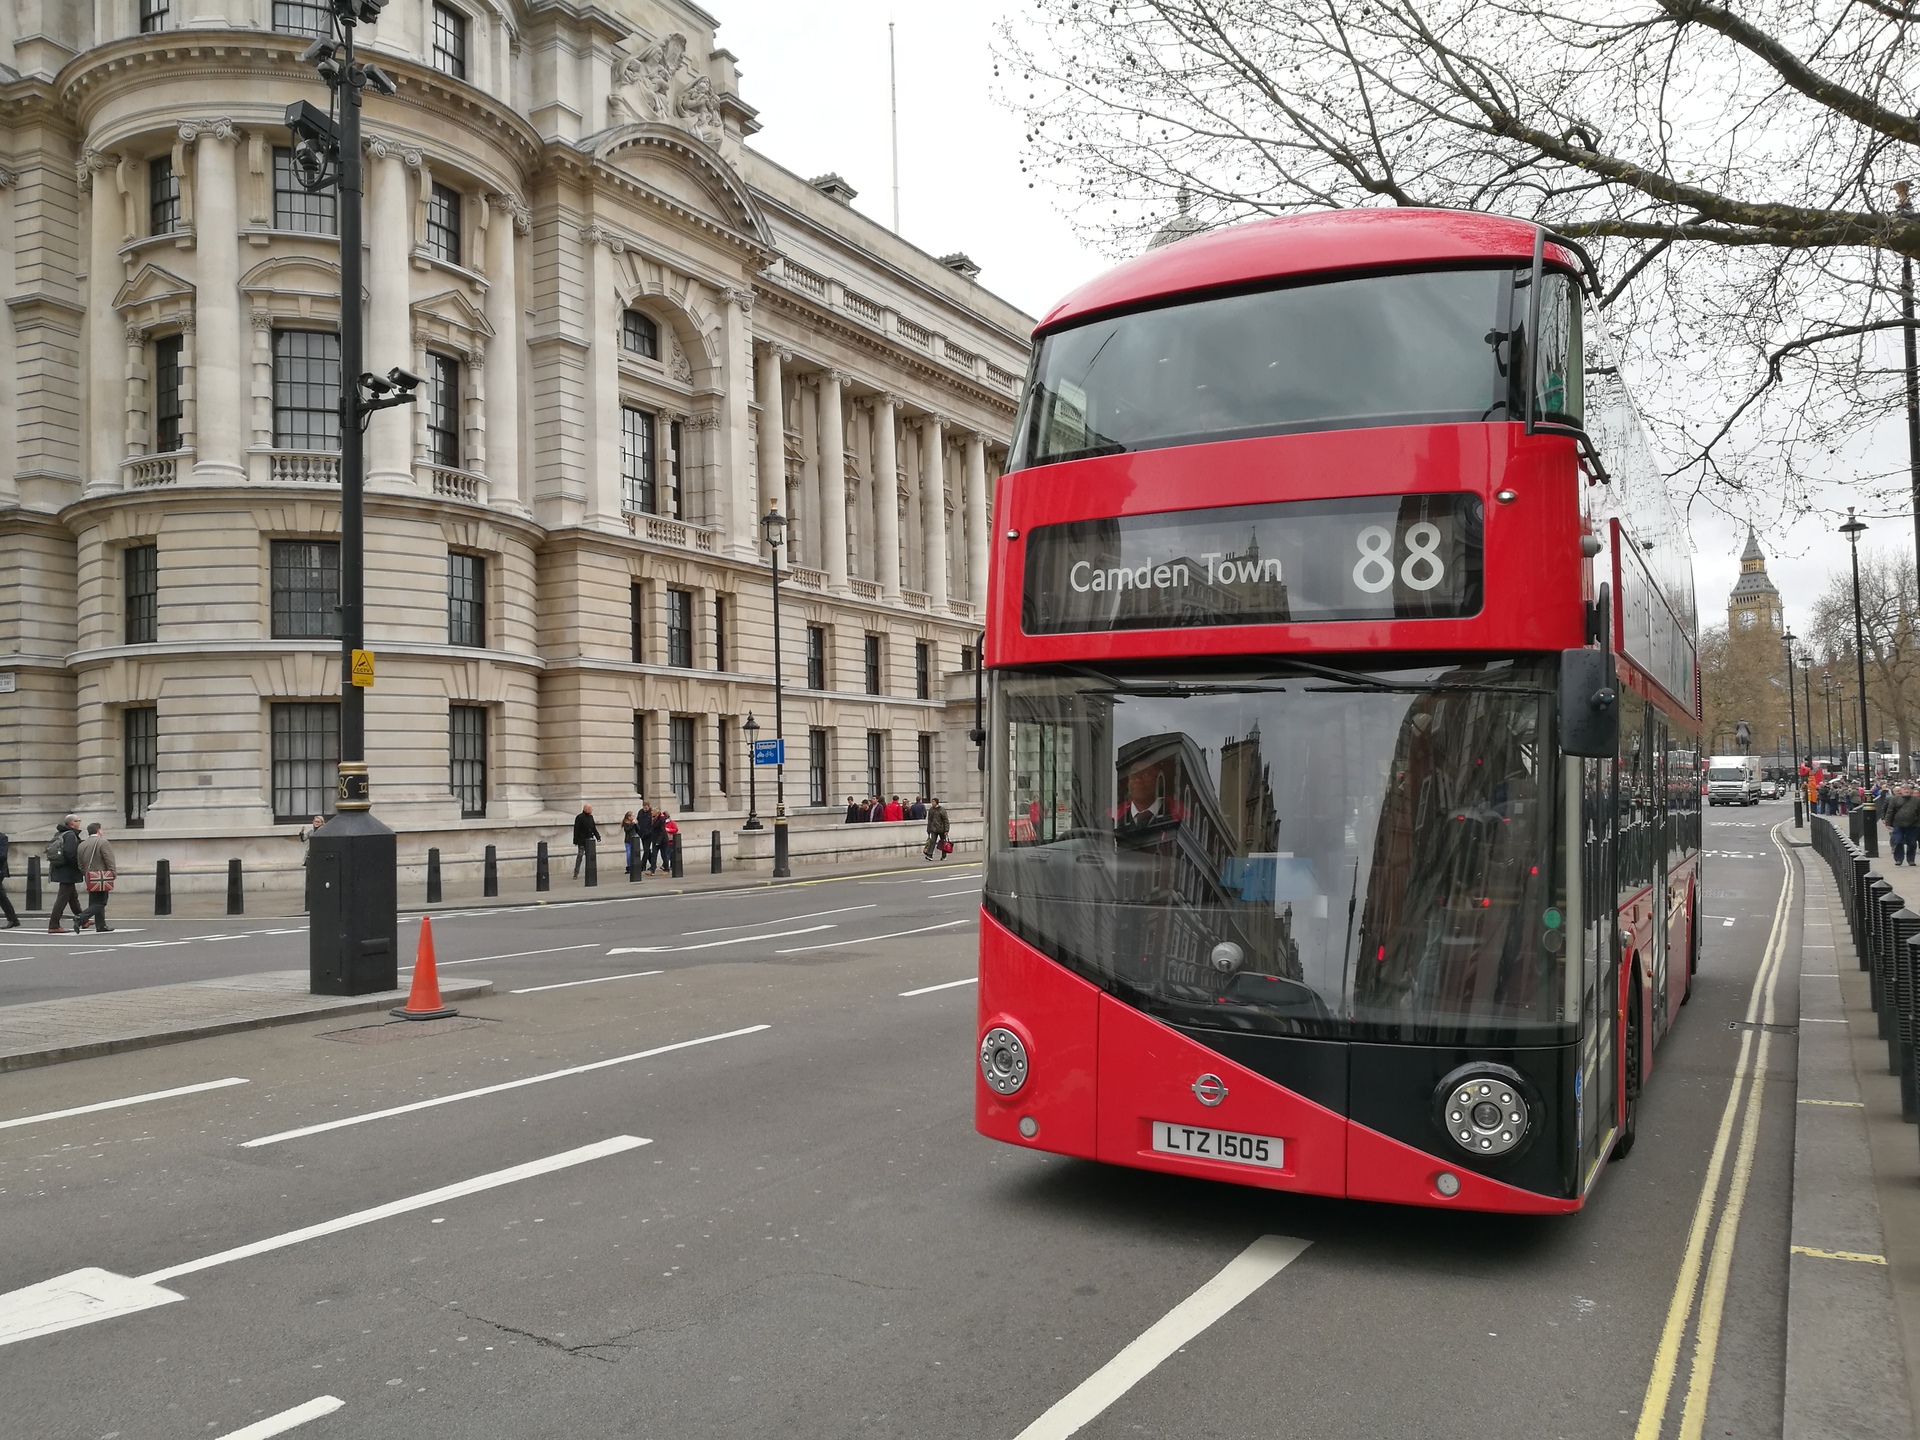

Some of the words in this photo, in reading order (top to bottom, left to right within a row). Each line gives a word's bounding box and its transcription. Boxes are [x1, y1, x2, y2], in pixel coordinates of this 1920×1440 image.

[1070, 556, 1189, 593] Camden
[1200, 552, 1282, 586] Town
[1352, 522, 1445, 593] 88
[1167, 1126, 1210, 1154] LTZ
[1217, 1133, 1269, 1162] 1505
